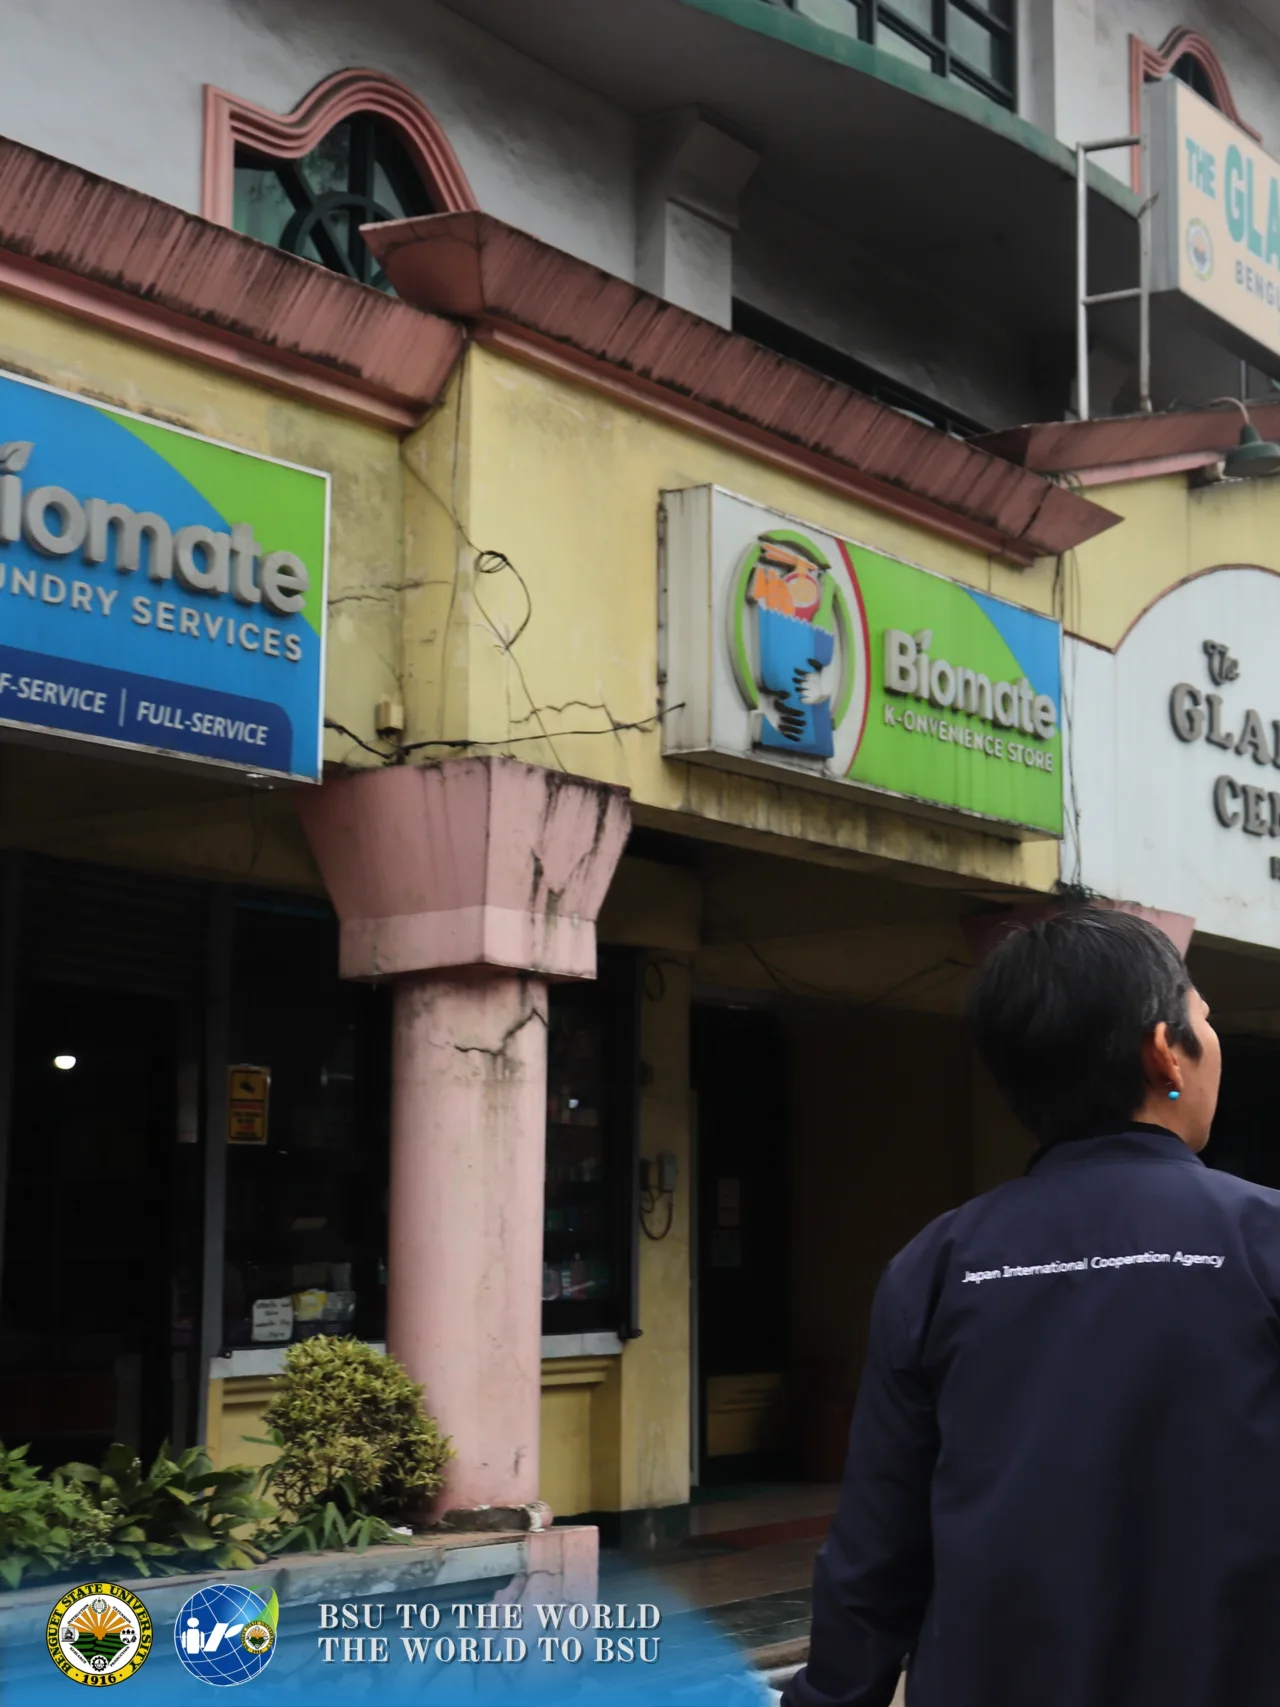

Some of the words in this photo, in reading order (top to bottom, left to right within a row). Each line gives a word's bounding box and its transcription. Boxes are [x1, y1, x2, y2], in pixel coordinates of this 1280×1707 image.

[1185, 136, 1216, 199] THE
[0, 563, 118, 616] NDRY
[131, 596, 303, 662] SERVICES
[883, 627, 1057, 740] Biomate
[136, 700, 269, 746] FULL-SERVICE
[883, 703, 1003, 758] K-ONVENIENCE
[1007, 740, 1054, 773] STORE
[962, 1270, 1001, 1285] Japan
[1002, 1257, 1088, 1278] International
[1090, 1250, 1171, 1269] Cooperation
[1172, 1250, 1226, 1268] Agency
